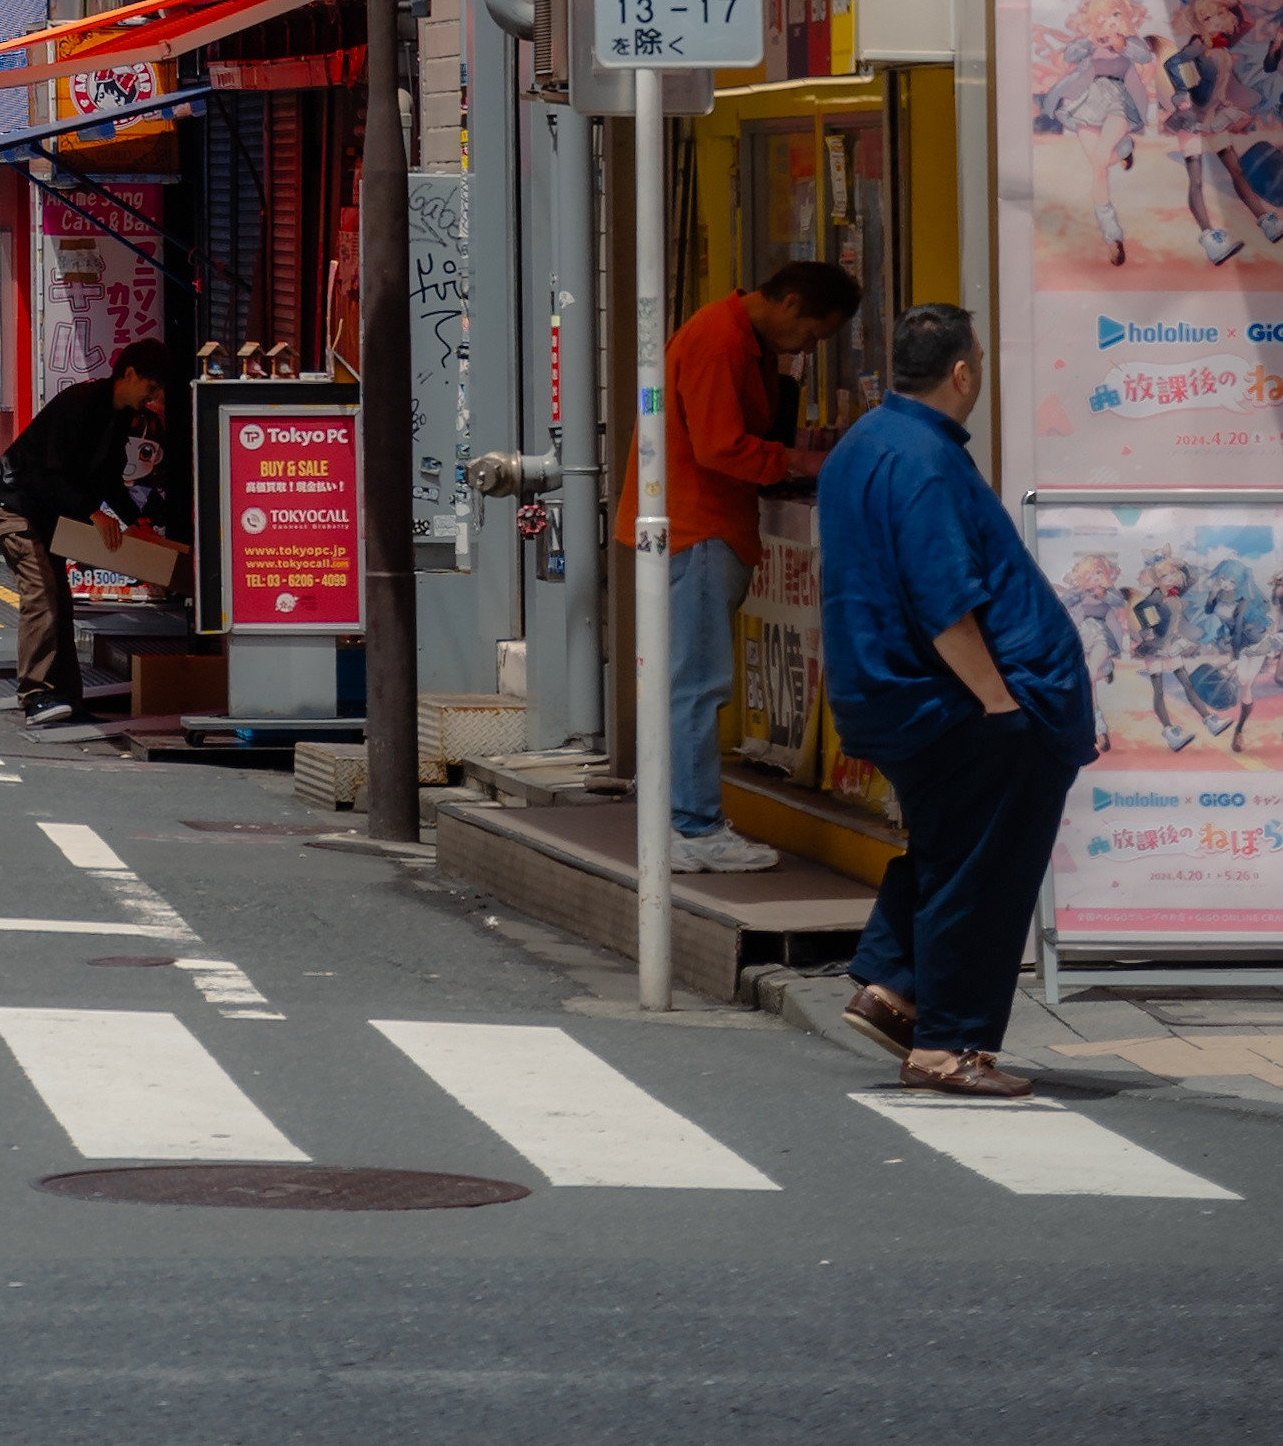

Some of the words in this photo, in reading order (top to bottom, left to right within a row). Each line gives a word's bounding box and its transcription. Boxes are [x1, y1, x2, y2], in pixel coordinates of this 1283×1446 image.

[612, 27, 685, 57] を除く
[1127, 314, 1219, 345] hololive
[1123, 366, 1237, 406] 放課後の
[267, 426, 325, 447] Tokyo
[326, 428, 349, 444] PC
[259, 460, 286, 478] BUY
[286, 461, 296, 477] &
[297, 460, 329, 477] SALE
[269, 509, 350, 524] TOKYOCALL
[244, 545, 347, 558] www.tokyopc.jp
[267, 574, 280, 588] 03
[288, 574, 314, 588] 6206
[1113, 791, 1179, 809] hololive
[1198, 792, 1246, 809] GiGO
[1111, 824, 1193, 851] 放課後の
